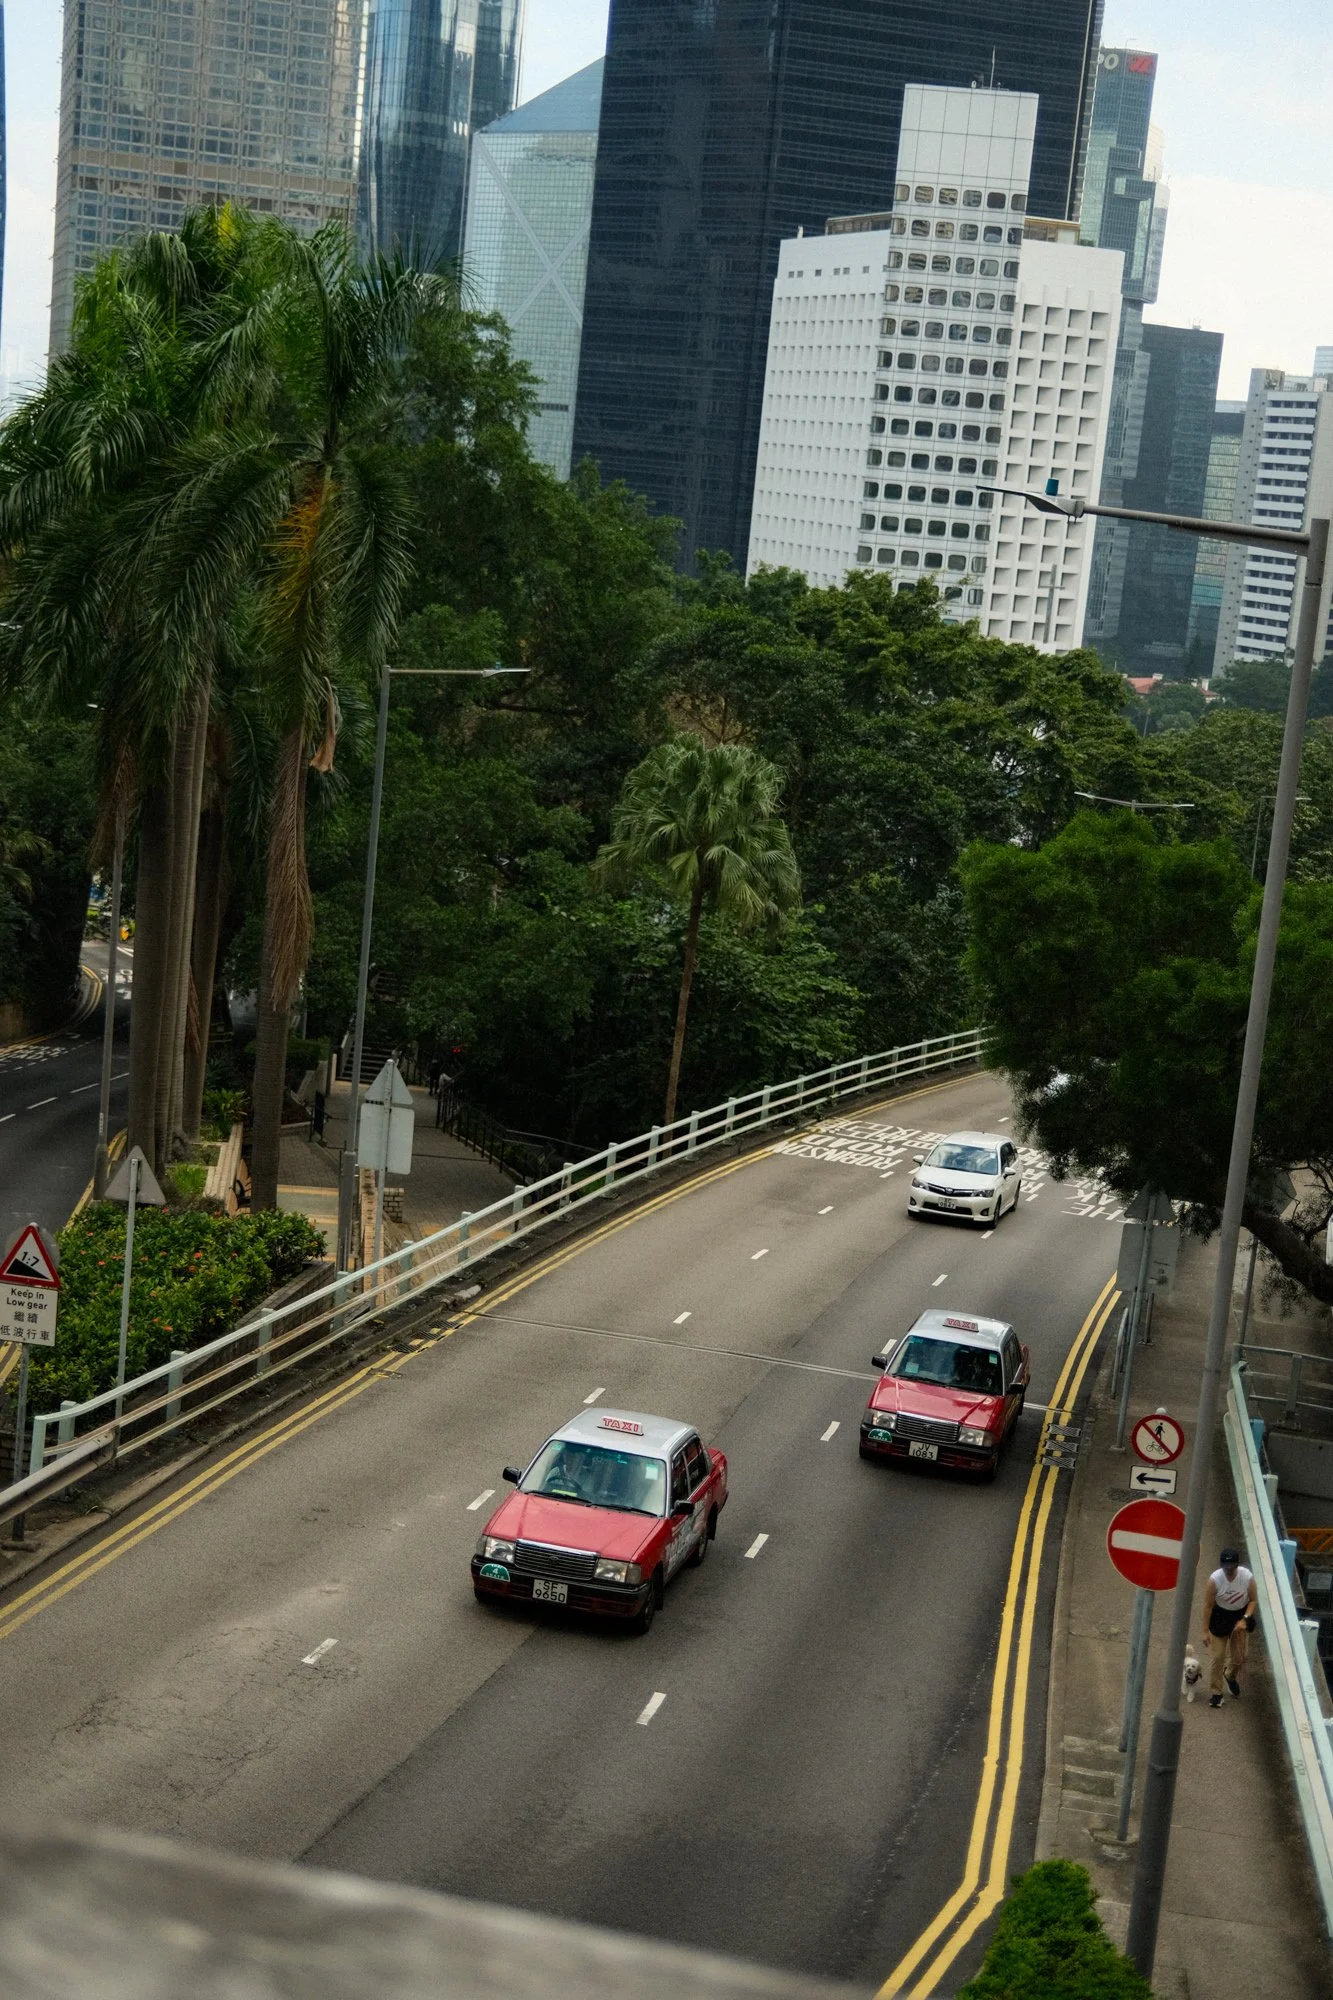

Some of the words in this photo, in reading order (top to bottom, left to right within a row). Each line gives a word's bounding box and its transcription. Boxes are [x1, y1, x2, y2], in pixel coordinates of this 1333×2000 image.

[801, 1134, 908, 1157] ROAD
[772, 1141, 903, 1170] ROBINSON
[22, 1251, 40, 1267] 1:7
[11, 1288, 34, 1299] Keep
[36, 1288, 45, 1300] in
[6, 1297, 25, 1307] Low
[27, 1300, 48, 1310] gear
[947, 1318, 977, 1330] TAXI
[0, 1324, 50, 1341] 低波行車
[602, 1417, 640, 1433] TAXI
[492, 1567, 499, 1575] 4
[535, 1587, 566, 1602] 9650
[543, 1581, 558, 1593] SF
